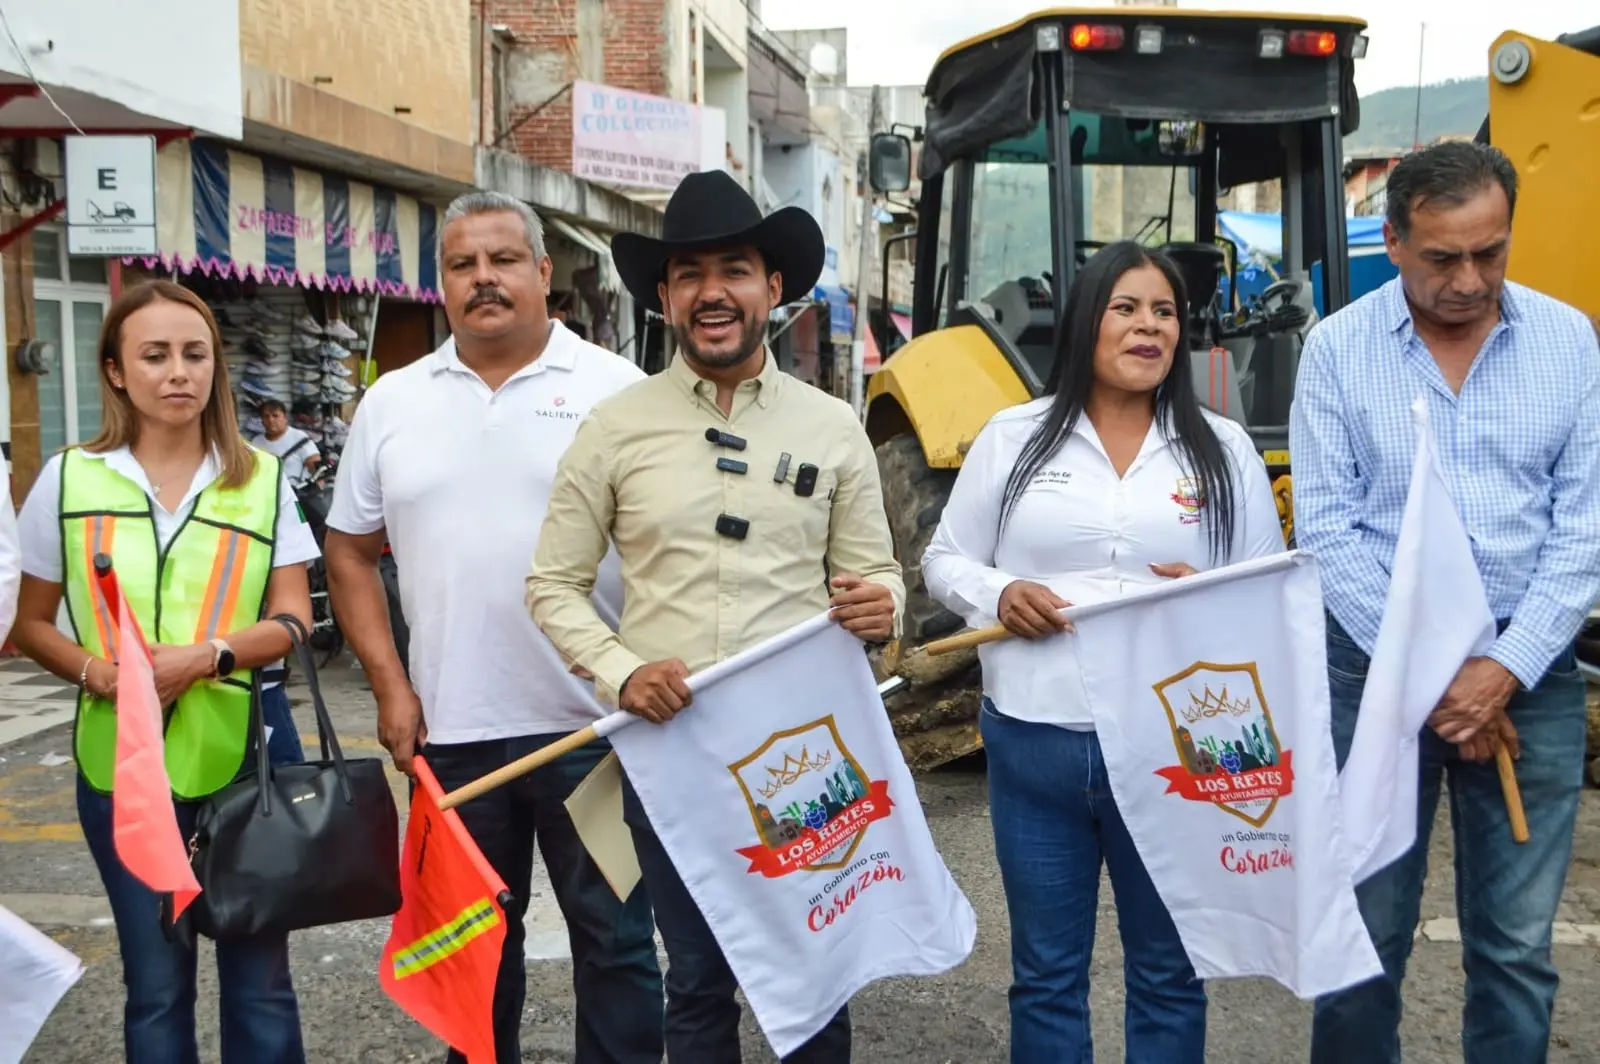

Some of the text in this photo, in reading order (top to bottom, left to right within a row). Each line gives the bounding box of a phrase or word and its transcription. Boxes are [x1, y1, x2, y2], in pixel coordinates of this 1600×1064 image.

[98, 169, 117, 190] E
[535, 410, 579, 420] SALIENT
[1195, 772, 1282, 792] LOS REYES
[1220, 788, 1279, 800] AYUNTAMIENTO
[776, 800, 875, 866] LOS REYES
[806, 817, 868, 862] AYUNTAMIENTO
[1222, 833, 1235, 842] un
[1236, 830, 1277, 841] Gobierno
[808, 850, 890, 905] un Gobierno con
[807, 860, 905, 932] Corazón
